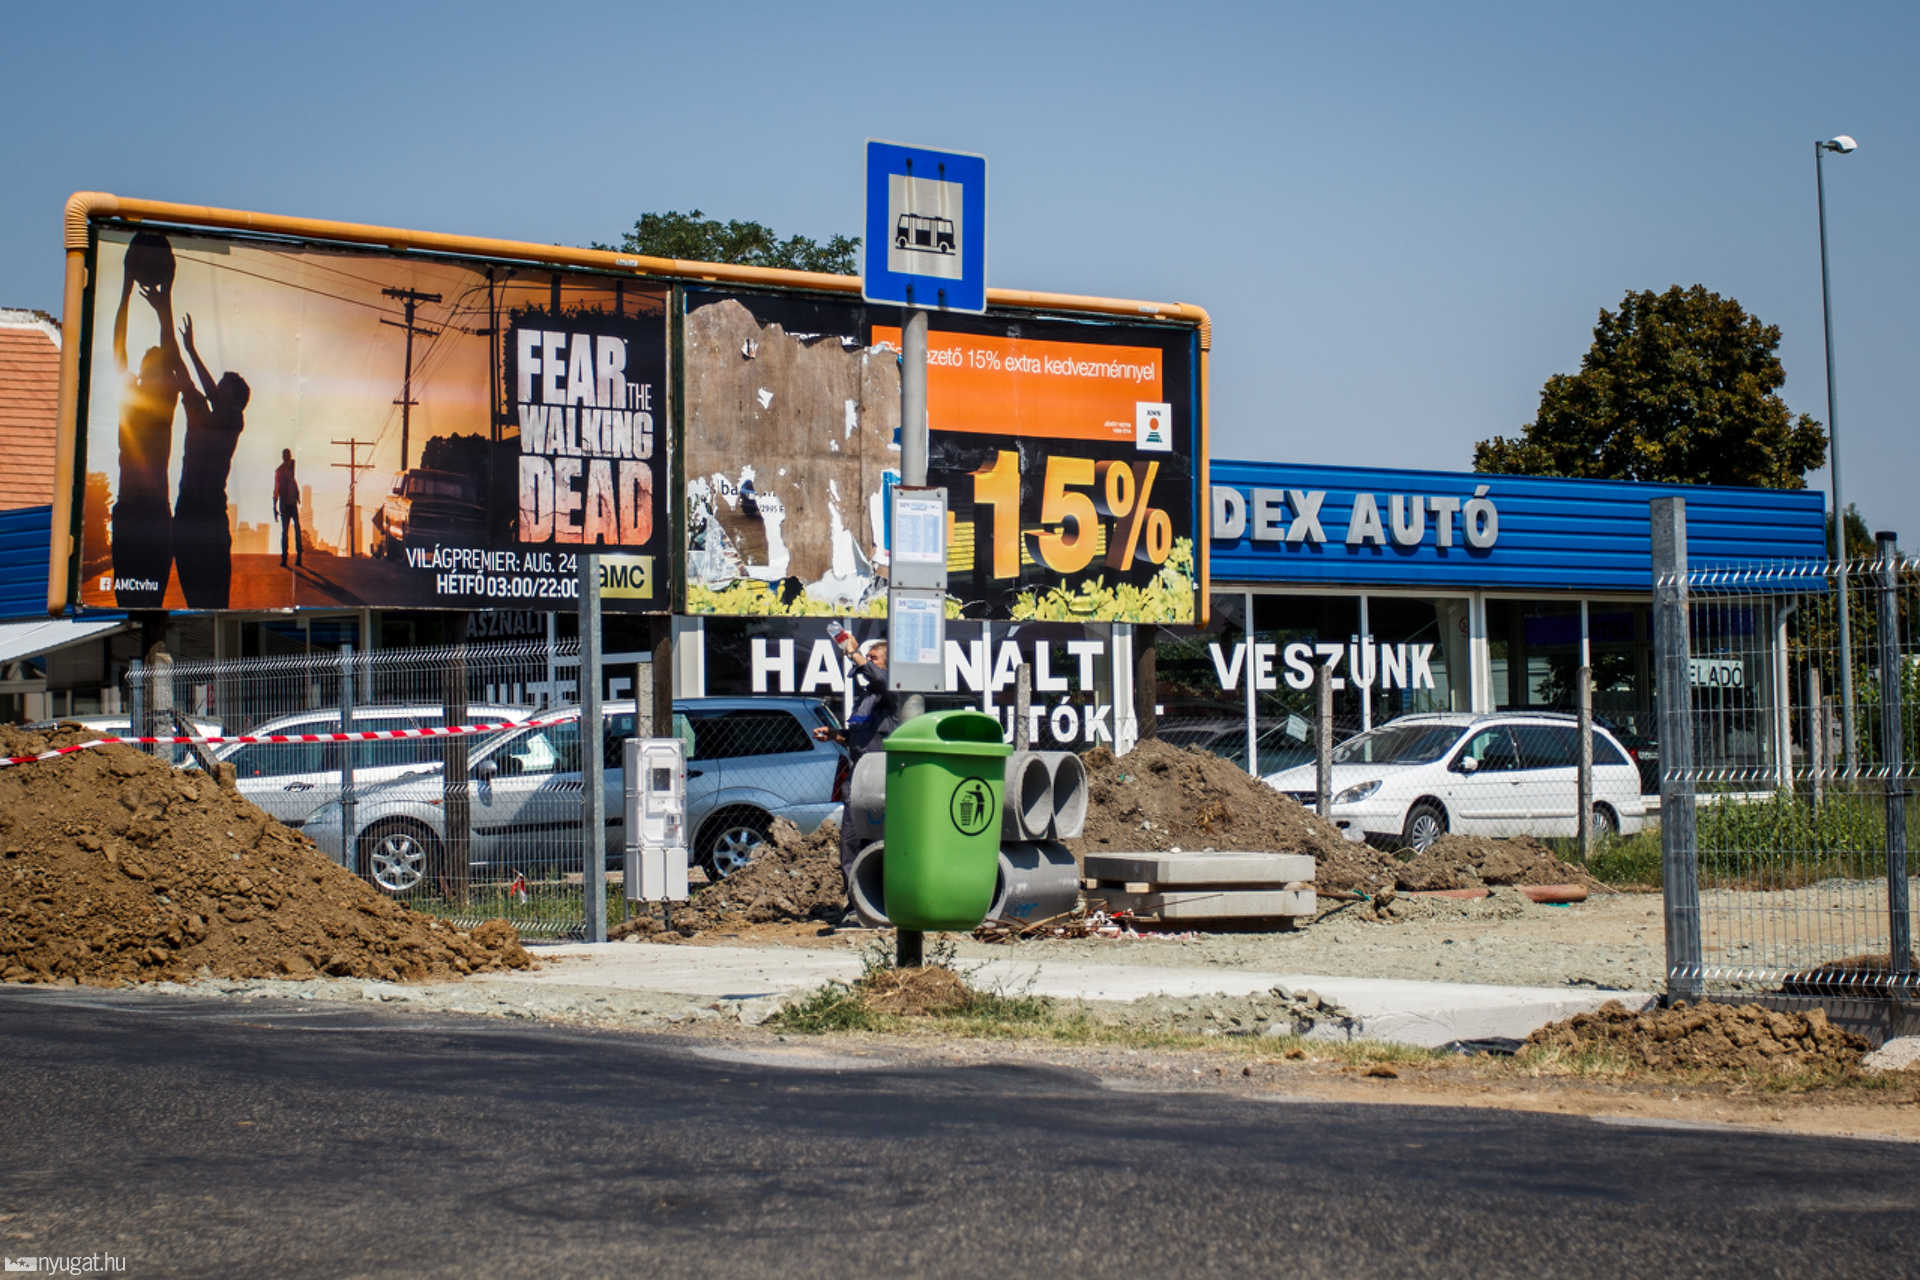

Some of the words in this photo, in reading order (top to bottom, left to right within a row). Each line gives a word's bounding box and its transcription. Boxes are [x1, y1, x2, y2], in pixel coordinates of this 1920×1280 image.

[517, 328, 626, 408] FEAR
[627, 382, 652, 411] THE
[968, 350, 1001, 370] 15%
[1005, 355, 1042, 373] extra
[1044, 355, 1155, 383] kedvezménnyel
[518, 404, 654, 460] WALKING
[518, 455, 653, 546] DEAD
[1345, 484, 1499, 548] AUTÓ
[405, 543, 520, 573] VILÁGPREMIER:
[523, 552, 556, 574] AUG.
[558, 552, 578, 574] 24
[436, 568, 485, 596] HÉTFŐ
[486, 576, 579, 599] 03:00/22:00
[750, 625, 1105, 693] HANÁLT
[1208, 633, 1436, 691] VESZÜNK
